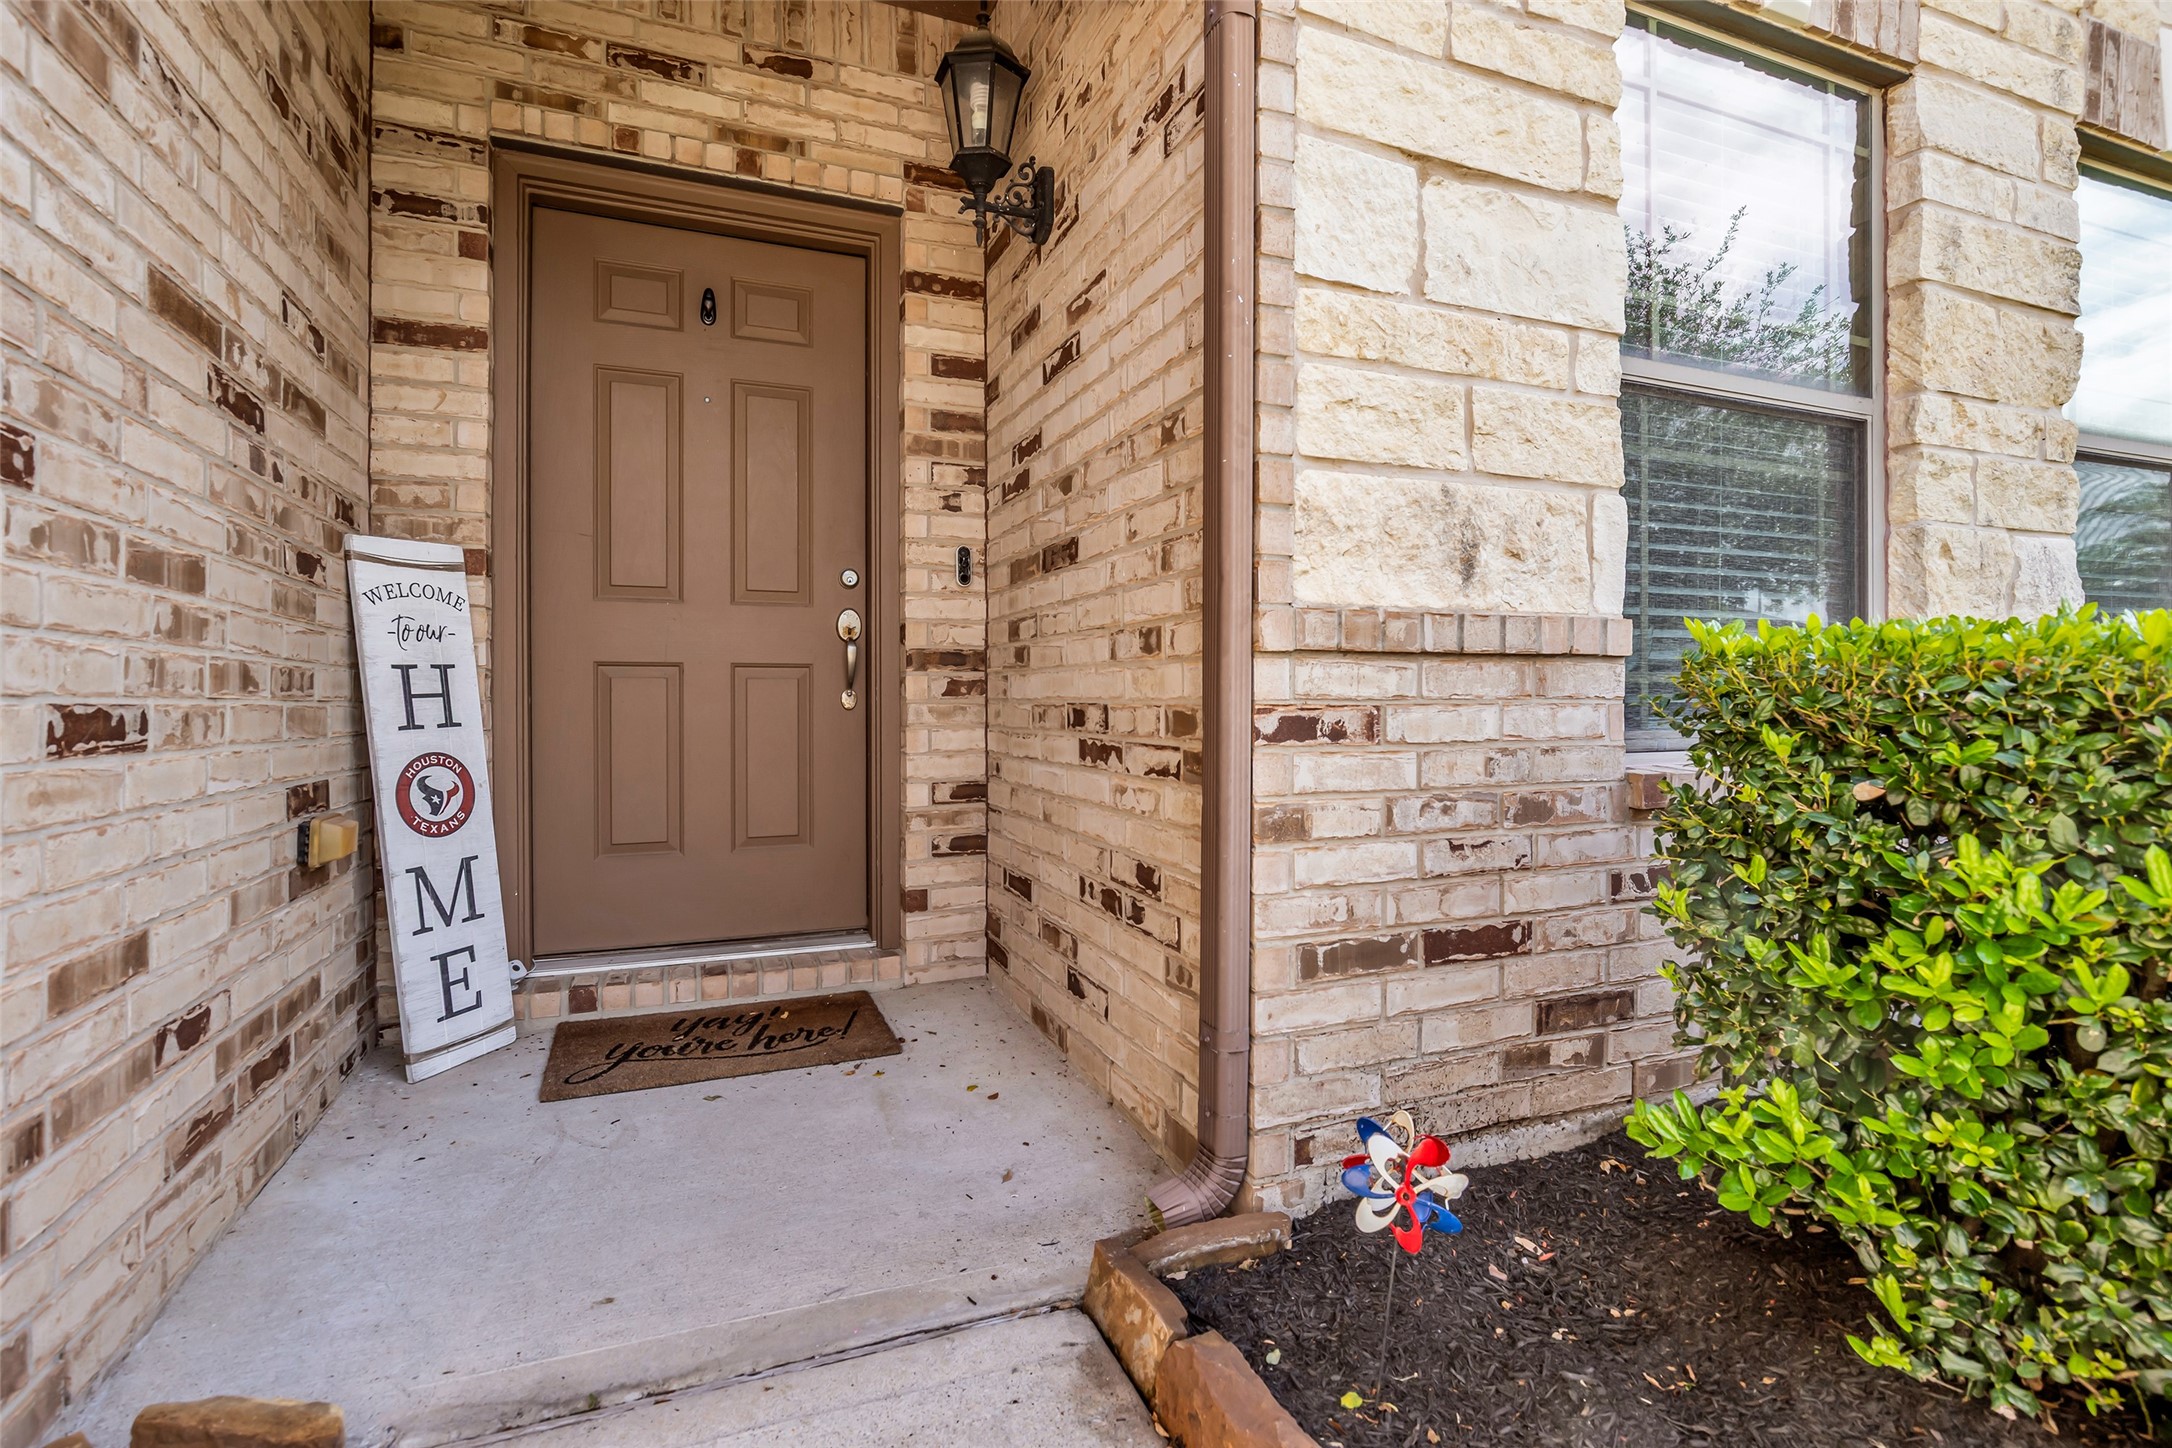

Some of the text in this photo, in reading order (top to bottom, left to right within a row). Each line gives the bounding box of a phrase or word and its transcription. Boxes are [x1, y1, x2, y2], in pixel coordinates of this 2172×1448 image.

[362, 582, 466, 612] WELCOME
[405, 755, 462, 779] HOUSTON
[411, 810, 466, 834] TEXANS
[564, 1009, 859, 1085] you're here!
